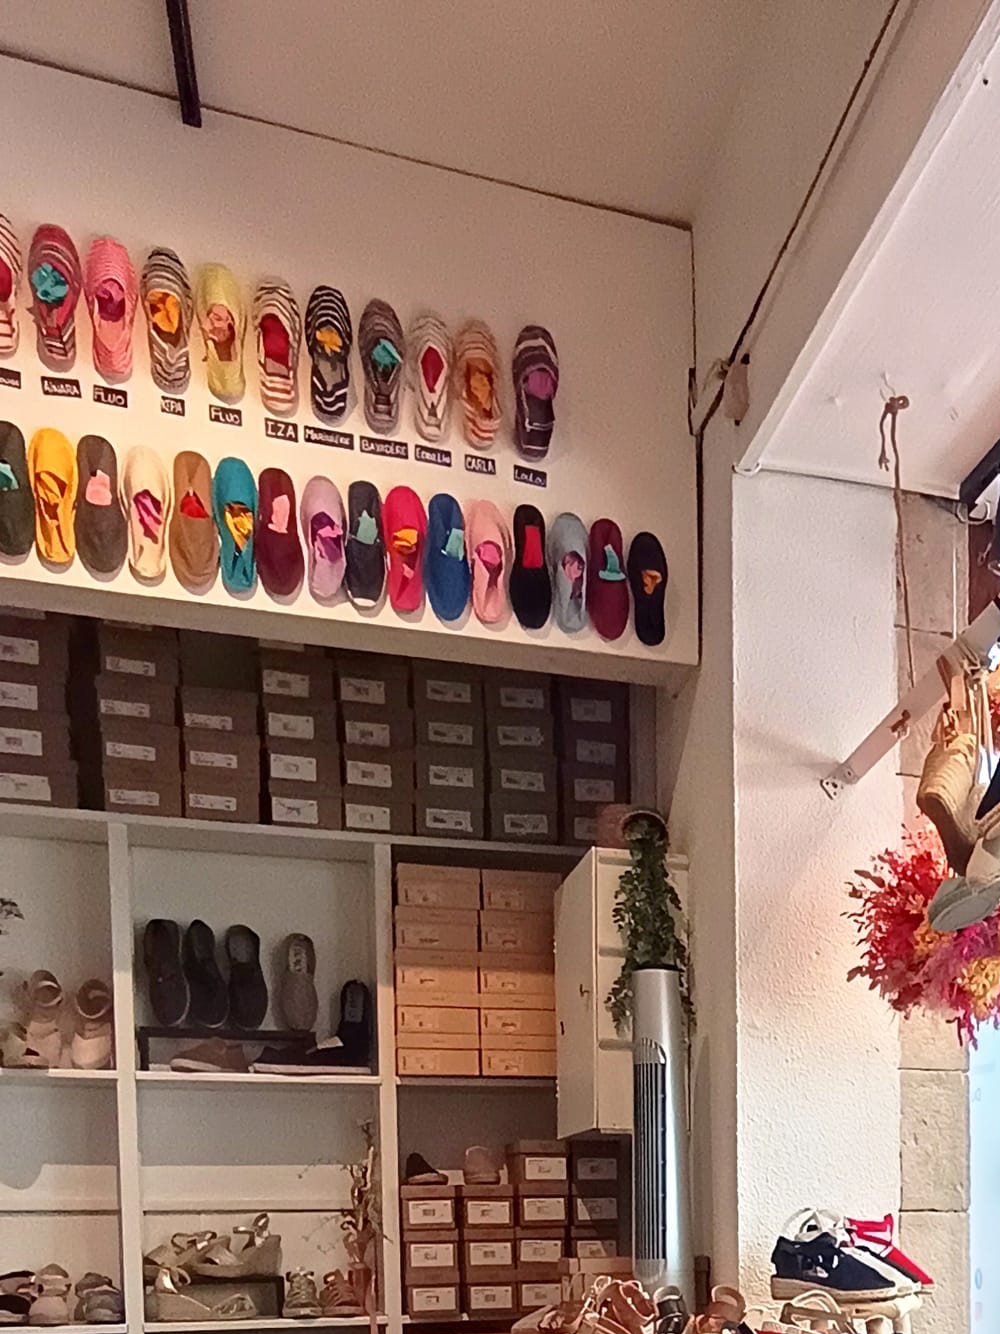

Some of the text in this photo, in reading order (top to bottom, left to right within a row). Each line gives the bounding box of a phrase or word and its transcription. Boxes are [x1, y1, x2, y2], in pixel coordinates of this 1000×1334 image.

[94, 387, 126, 406] FLUO
[210, 406, 241, 425] FLUO
[266, 420, 297, 440] IZA
[465, 456, 495, 473] CARLA
